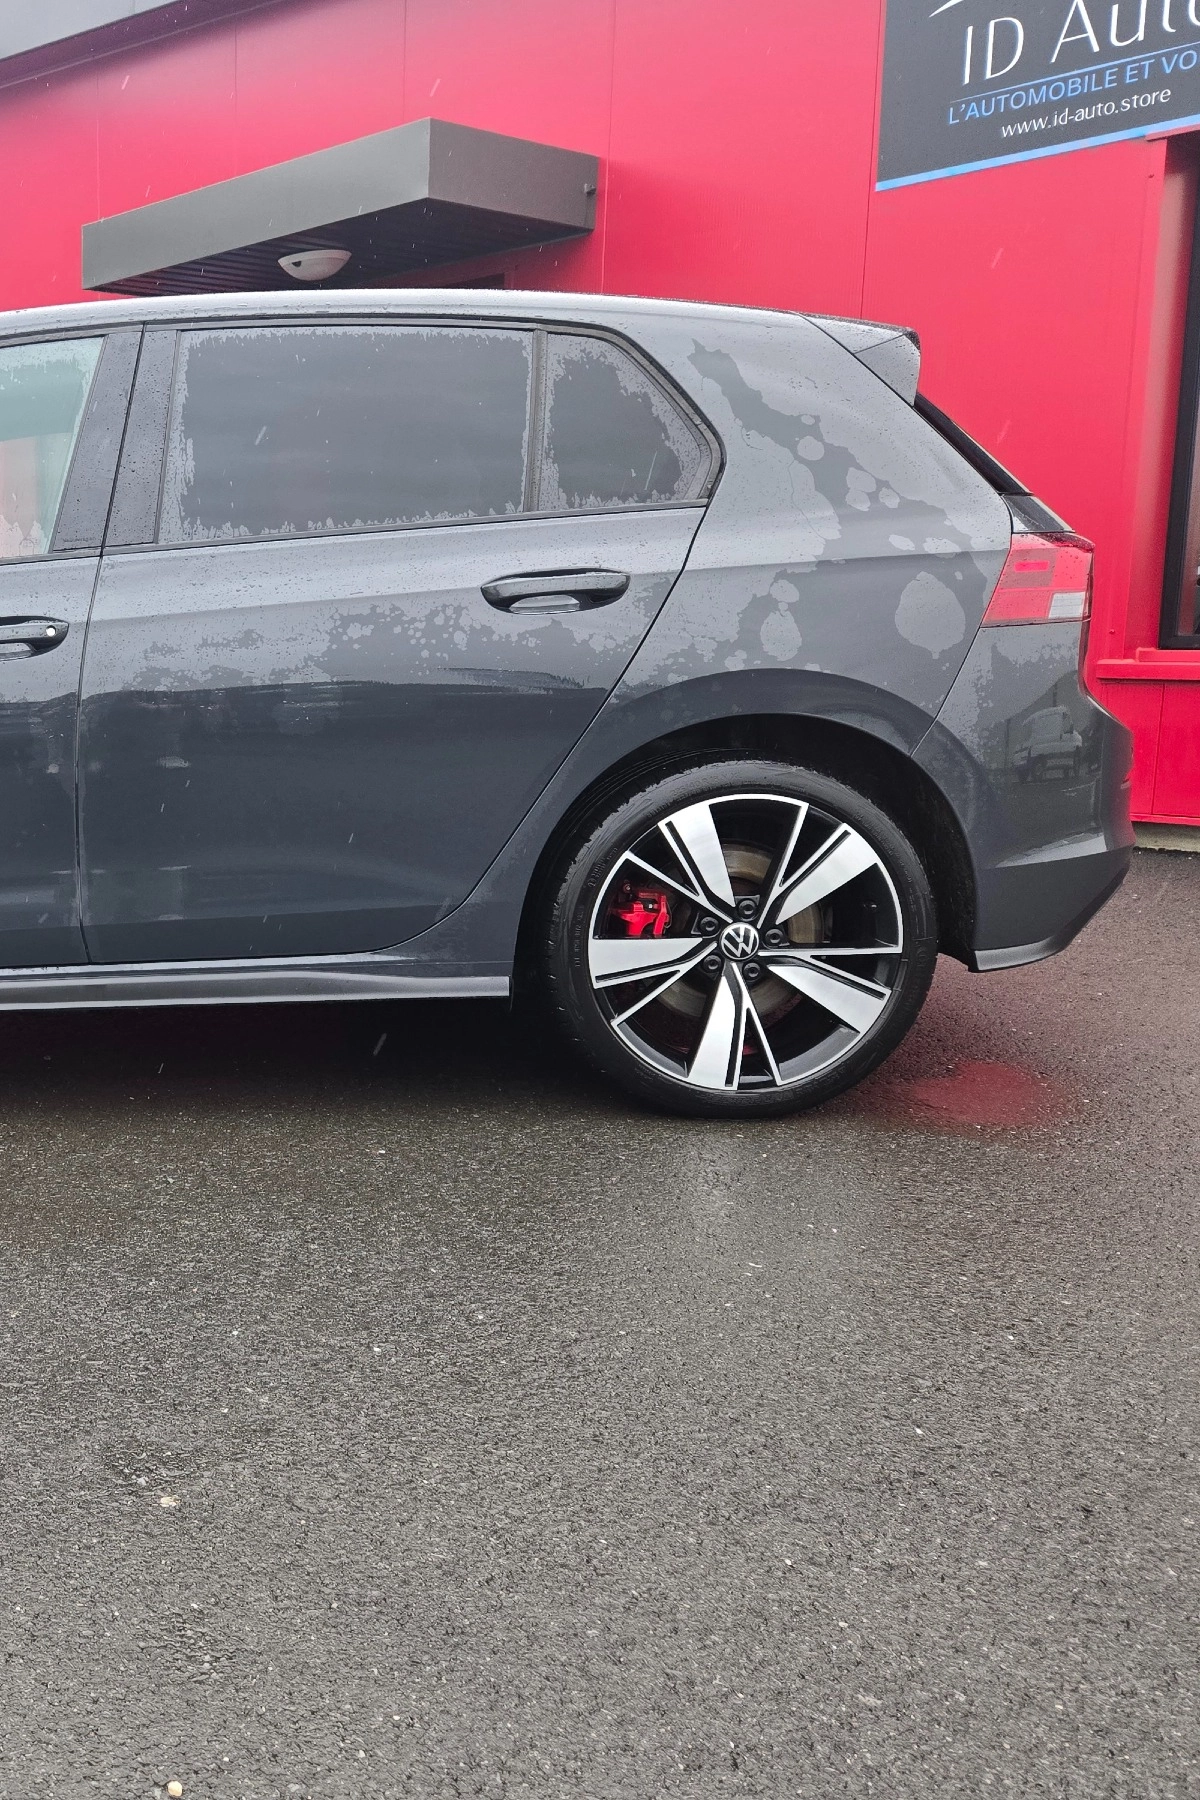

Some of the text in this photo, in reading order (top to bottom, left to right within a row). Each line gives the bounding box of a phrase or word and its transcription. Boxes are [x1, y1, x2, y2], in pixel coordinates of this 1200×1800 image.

[962, 17, 1025, 86] ID
[1125, 59, 1155, 84] ET
[1001, 87, 1172, 138] www.id-auto.store
